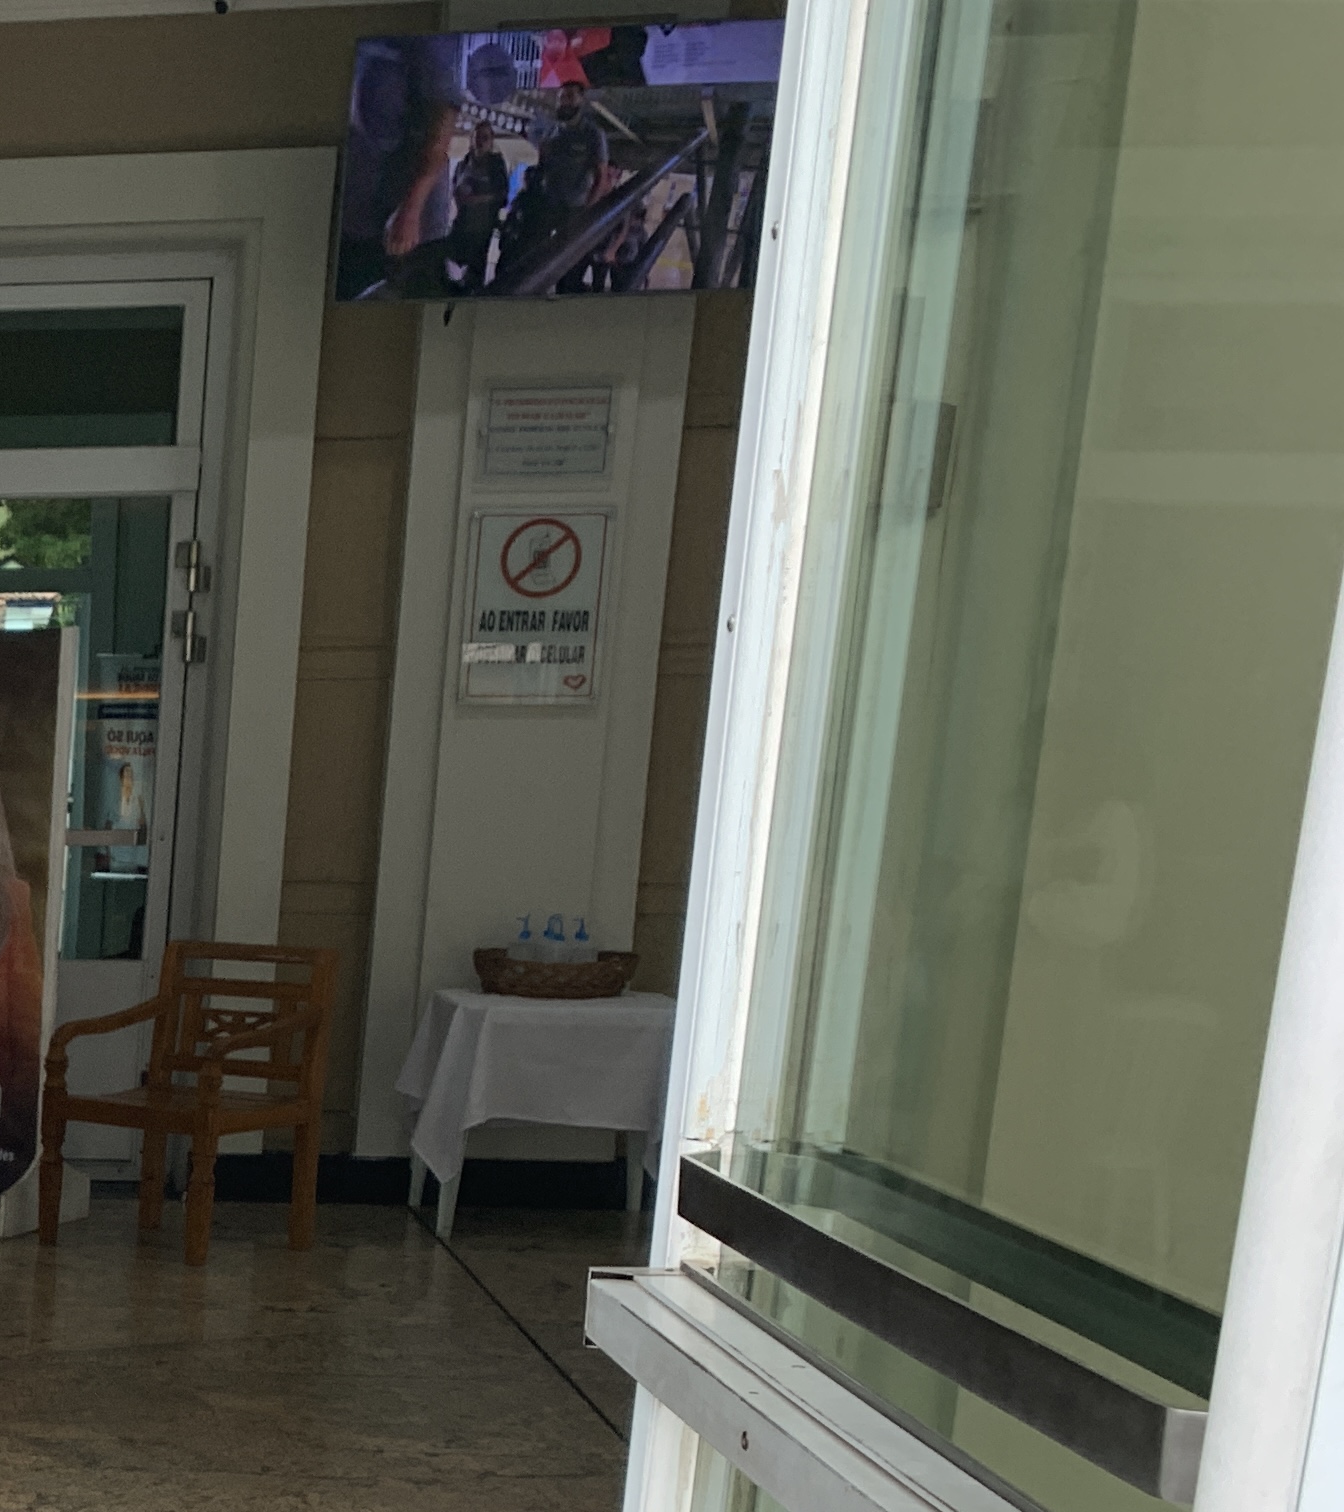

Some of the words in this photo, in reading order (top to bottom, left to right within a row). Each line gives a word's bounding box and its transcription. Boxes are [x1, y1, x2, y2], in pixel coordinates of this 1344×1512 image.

[479, 610, 496, 632] AO
[499, 610, 546, 632] ENTRAR
[552, 610, 590, 632] FAVOR
